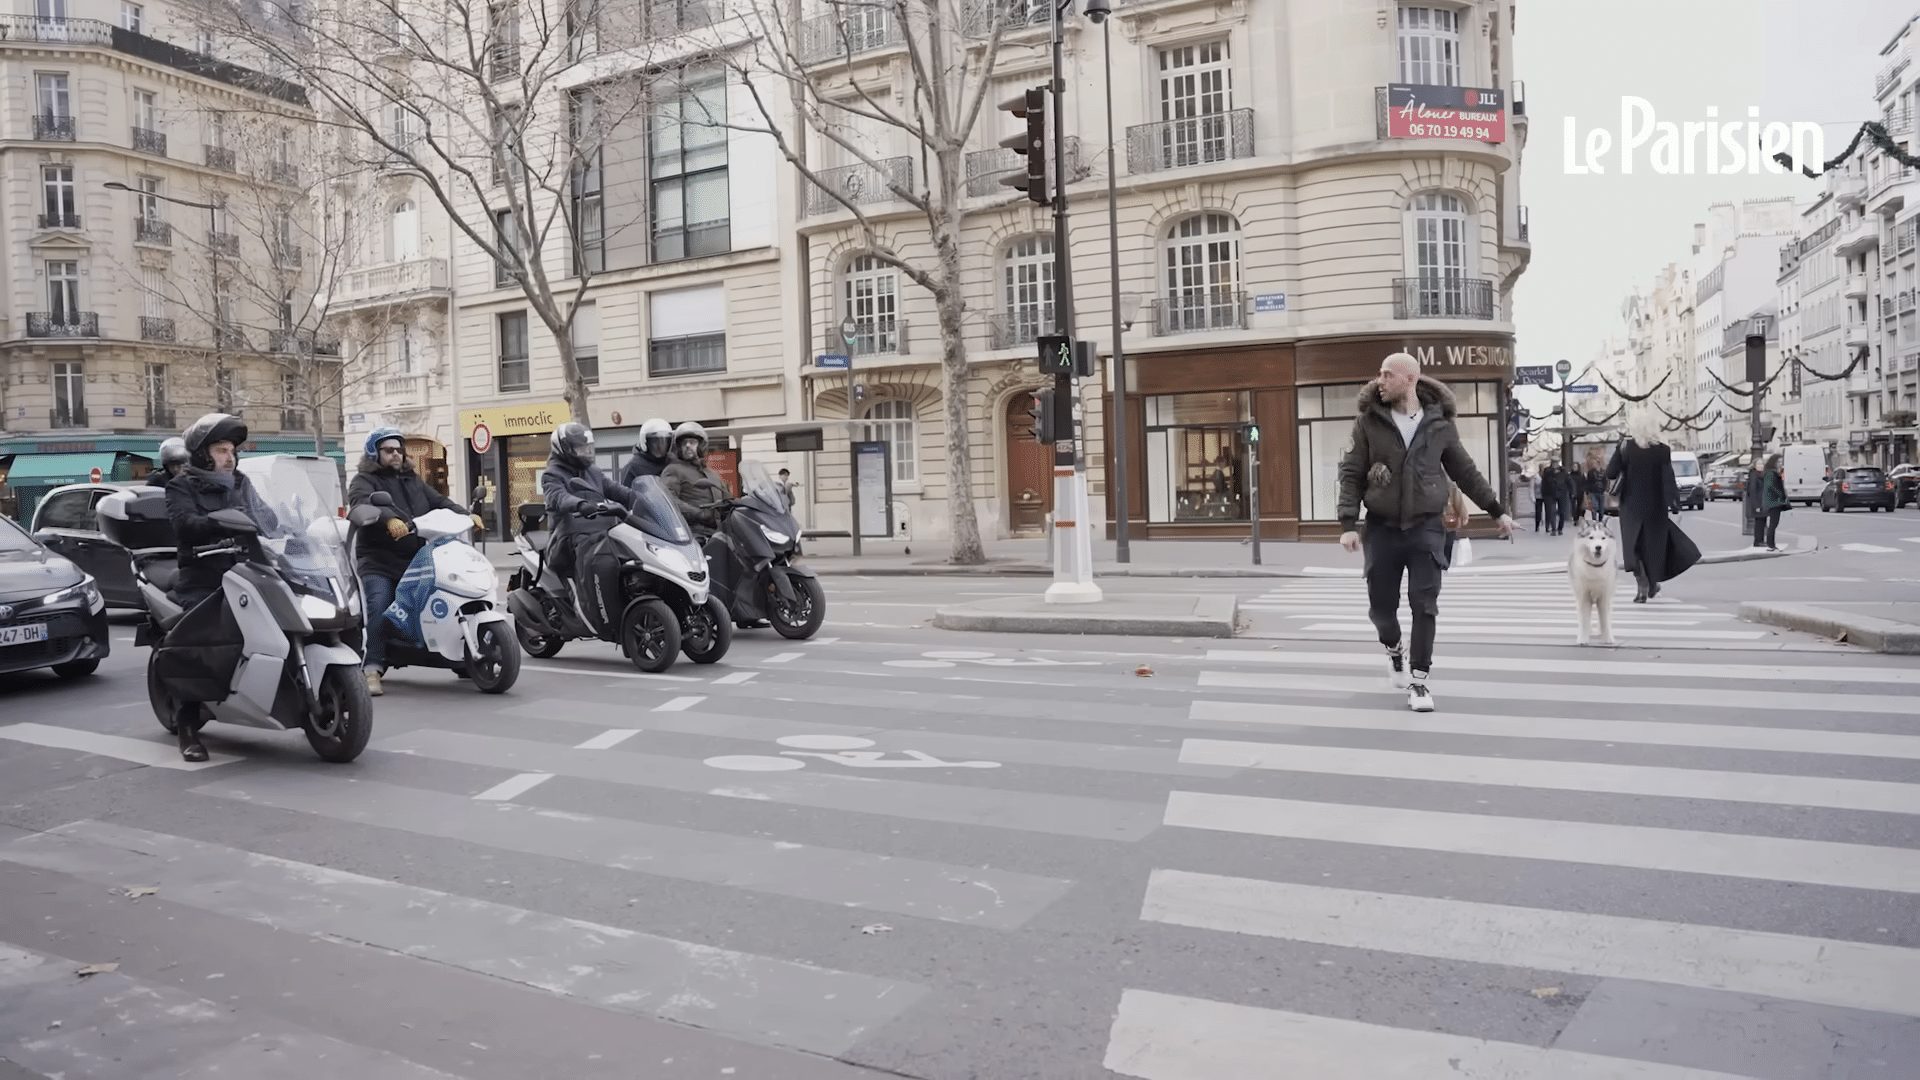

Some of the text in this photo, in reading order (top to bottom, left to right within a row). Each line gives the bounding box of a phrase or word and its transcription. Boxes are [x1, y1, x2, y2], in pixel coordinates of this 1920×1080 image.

[1400, 94, 1498, 122] À louer BUREAUX
[1478, 93, 1497, 105] JLL
[1409, 124, 1489, 138] 06 70 19 49 94
[504, 410, 553, 428] immoclic
[0, 626, 40, 644] 47-DH
